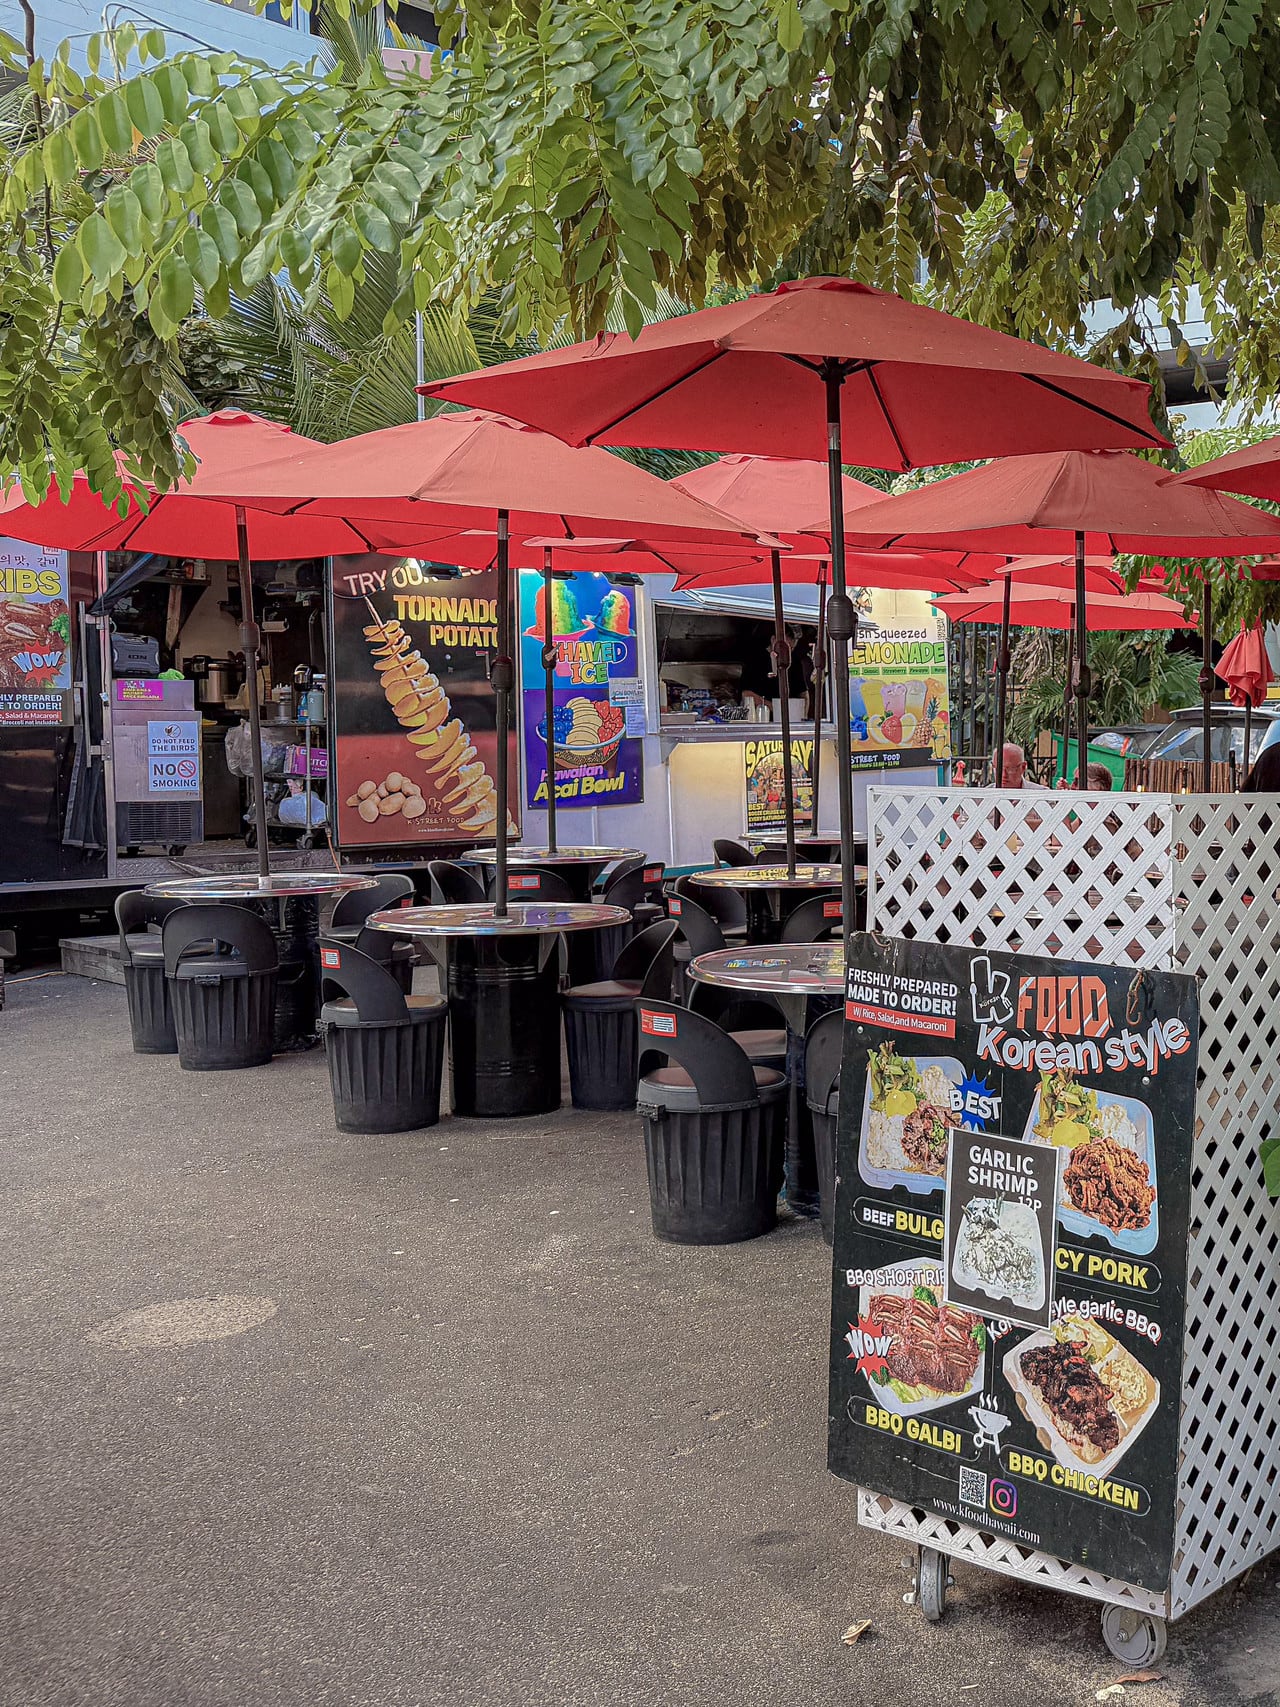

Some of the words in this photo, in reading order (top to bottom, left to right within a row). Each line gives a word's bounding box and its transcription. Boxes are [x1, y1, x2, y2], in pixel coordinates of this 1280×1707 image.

[343, 569, 386, 596] TRY
[391, 566, 430, 588] OU
[875, 628, 927, 640] Squeezed
[12, 651, 63, 673] WOW
[552, 640, 627, 663] HAVED
[570, 662, 609, 684] ICE
[16, 694, 63, 702] PREPARED
[24, 702, 62, 710] ORDER!
[153, 764, 176, 776] NO
[745, 740, 813, 778] SATURAY
[883, 753, 901, 761] FOOD
[580, 770, 625, 795] Bowl
[748, 803, 764, 811] BEST
[848, 968, 891, 987] FRESHLY
[893, 977, 958, 997] PREPARED
[848, 985, 881, 1002] MADE
[884, 989, 898, 1006] TO
[900, 993, 957, 1016] ORDER!
[1016, 976, 1114, 1038] FOOD
[911, 1017, 947, 1032] Macaroni
[977, 1024, 1102, 1075] Korean
[1106, 1016, 1191, 1075] style
[951, 1088, 1002, 1121] BEST
[968, 1145, 1035, 1176] GARLIC
[967, 1167, 1039, 1197] SHRIMP
[863, 1206, 894, 1227] BEEF
[846, 1268, 875, 1287] BBQ
[876, 1267, 923, 1287] SHORT
[1088, 1257, 1149, 1290] PORK
[1079, 1301, 1124, 1325] garlic
[1126, 1310, 1162, 1345] BBQ
[844, 1329, 893, 1358] WOW
[865, 1404, 903, 1434] BBQ
[906, 1420, 961, 1454] GALBI
[1008, 1451, 1048, 1481] BBQ
[1051, 1464, 1139, 1511] CHICKEN
[933, 1496, 1041, 1545] www.kfoodhawaii.com
